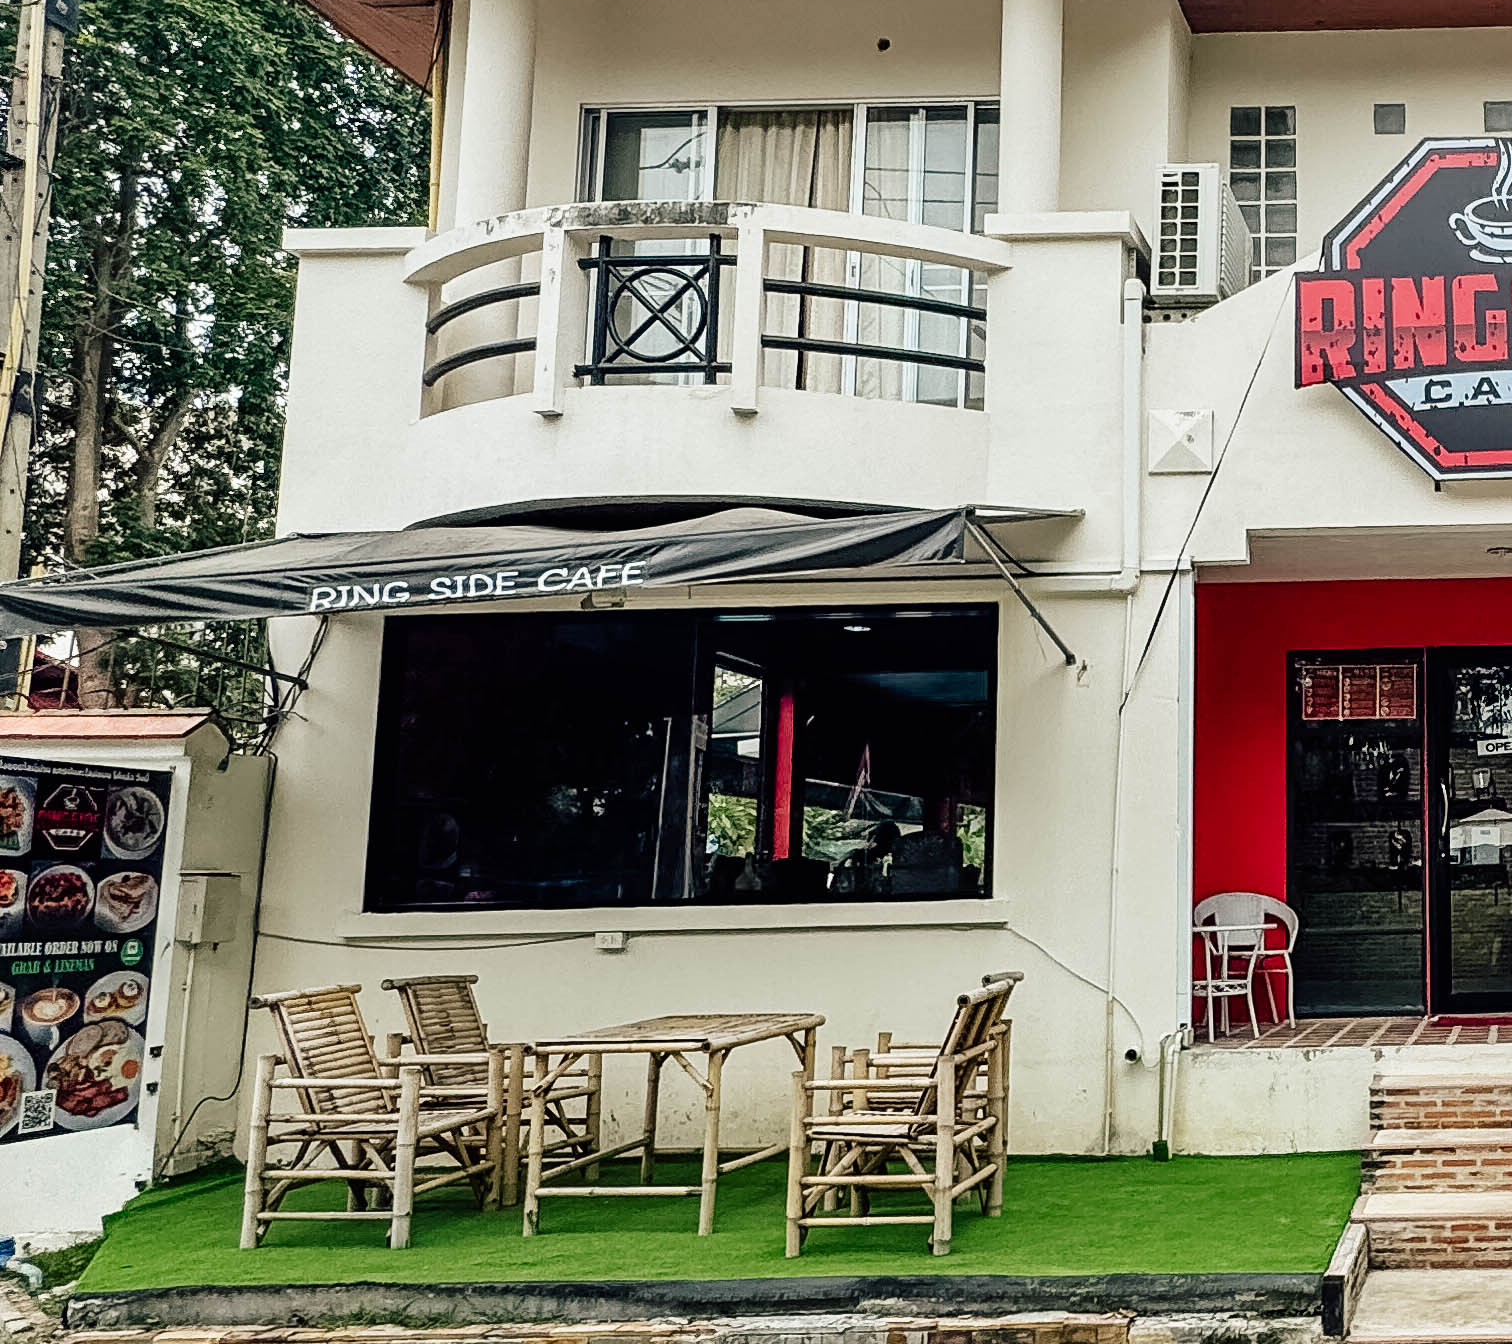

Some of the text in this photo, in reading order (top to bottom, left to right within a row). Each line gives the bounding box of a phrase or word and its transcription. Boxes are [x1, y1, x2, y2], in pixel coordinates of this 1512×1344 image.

[310, 561, 647, 613] RING SIDE CAFE
[44, 941, 79, 955] ORDER
[80, 940, 103, 954] NOW
[104, 939, 119, 953] ON
